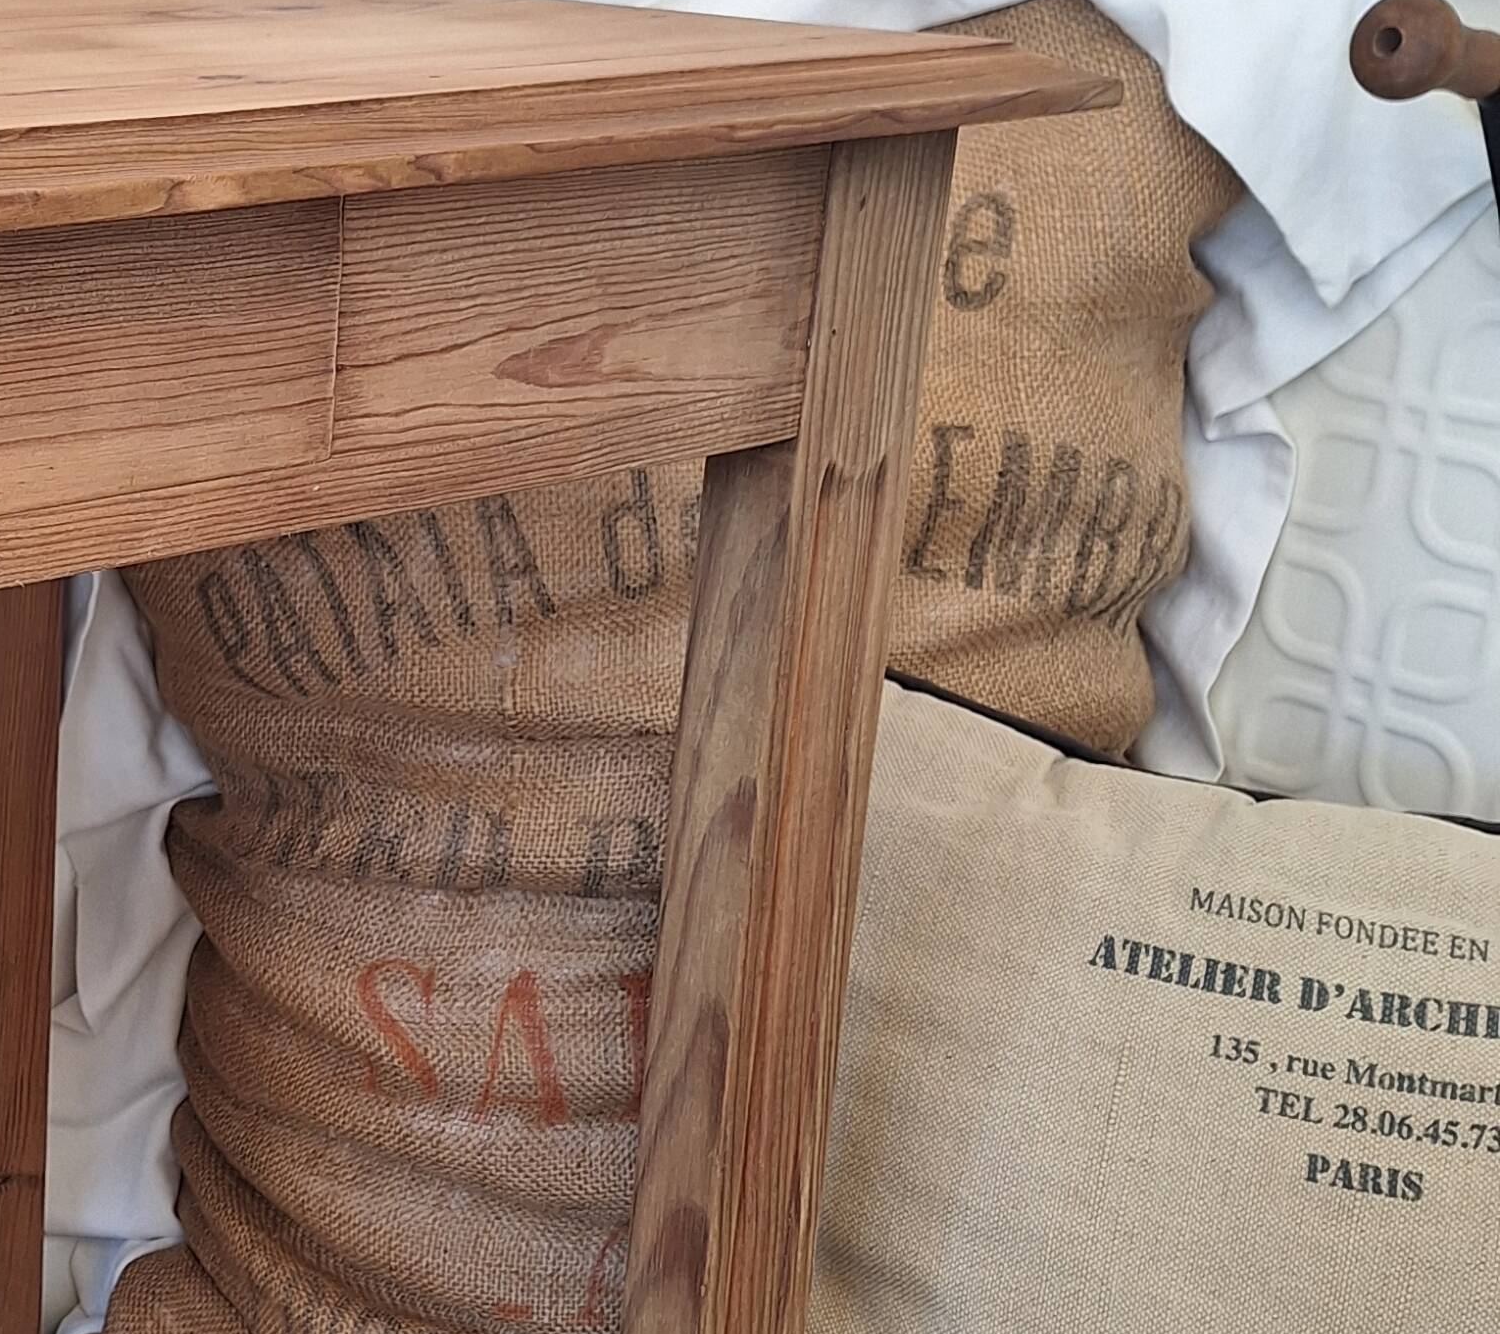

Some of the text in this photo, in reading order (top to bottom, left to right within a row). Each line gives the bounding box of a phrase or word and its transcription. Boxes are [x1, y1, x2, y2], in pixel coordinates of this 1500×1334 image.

[1190, 887, 1490, 963] MAISON FONDEE EN
[1088, 934, 1282, 1005] ATELIER
[1285, 1054, 1337, 1081] rue
[1255, 1085, 1324, 1125] TEL
[1304, 1152, 1424, 1203] PARIS
